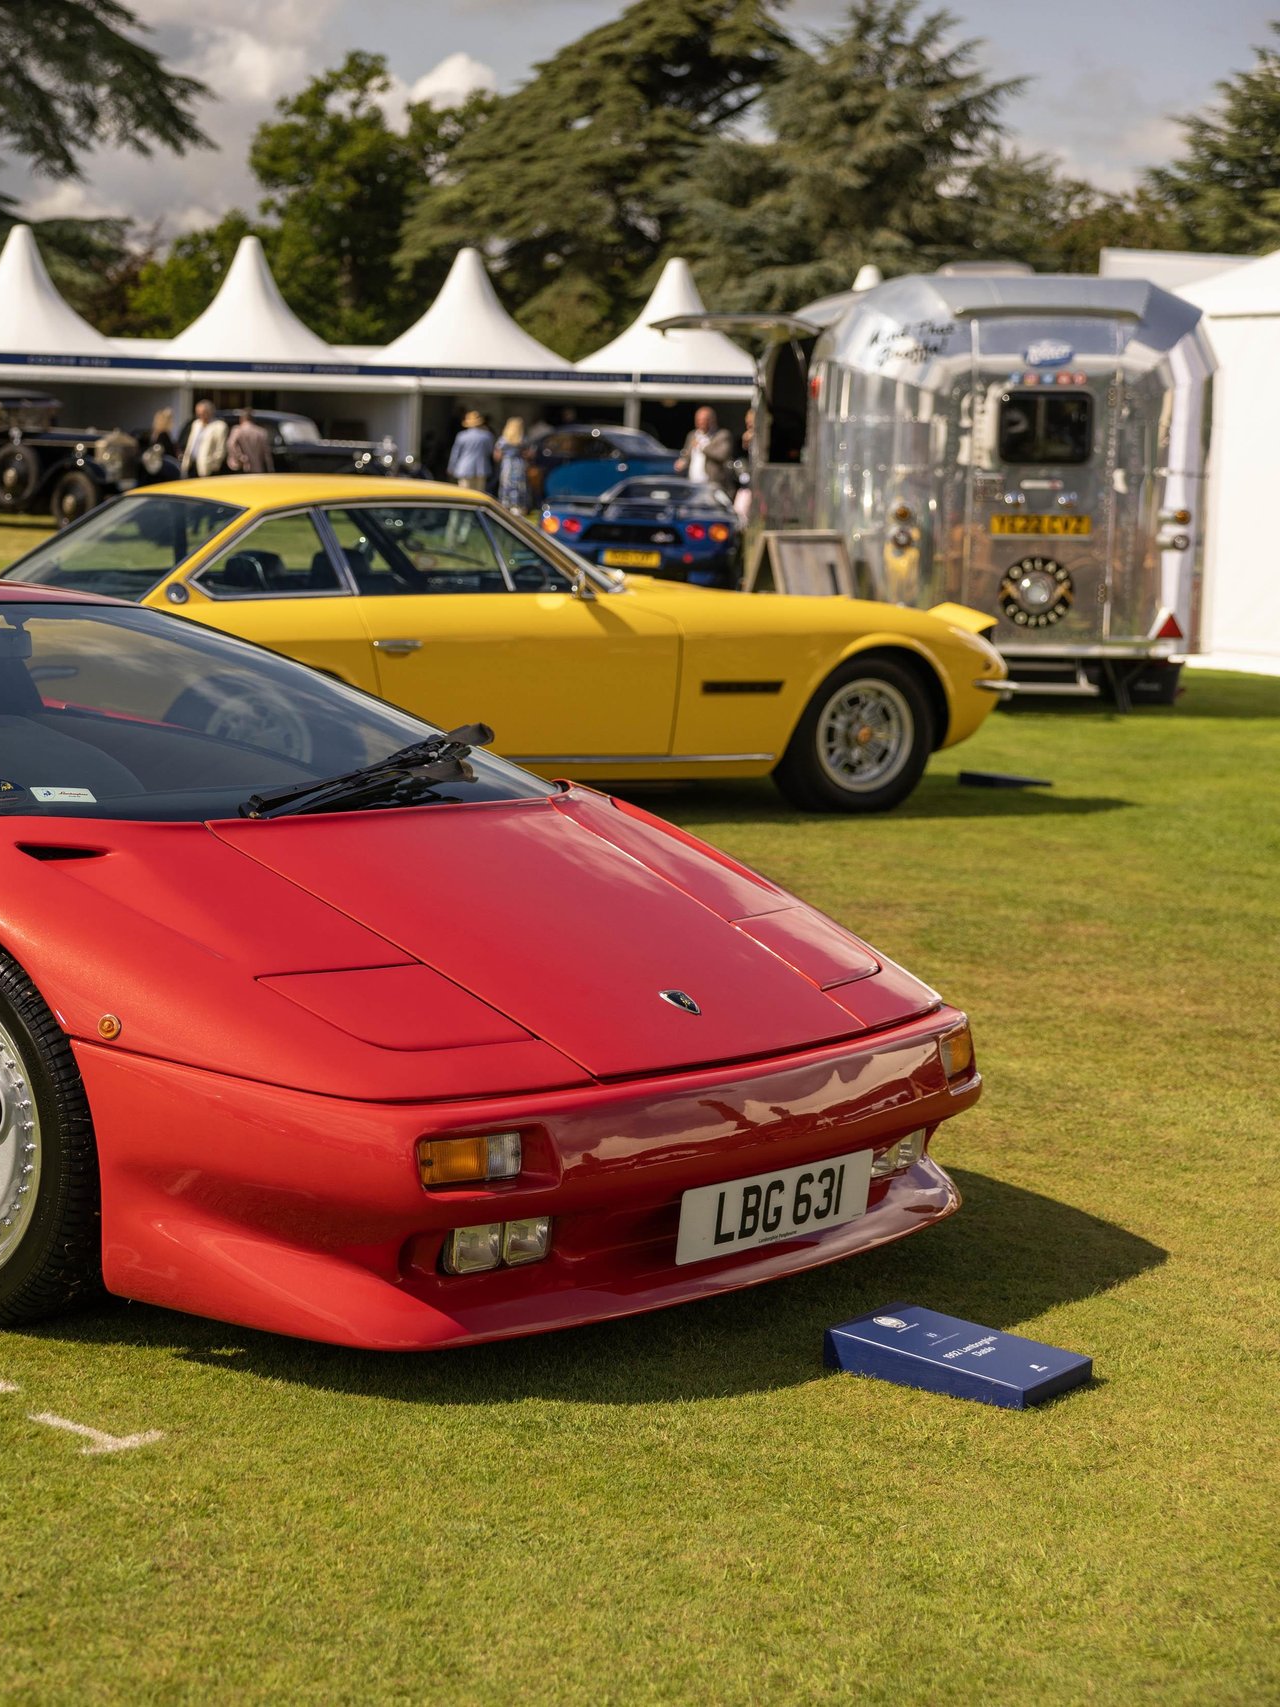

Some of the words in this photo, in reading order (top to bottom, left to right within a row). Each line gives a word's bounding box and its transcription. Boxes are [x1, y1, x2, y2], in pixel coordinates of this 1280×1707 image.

[714, 1180, 785, 1246] LBG
[792, 1164, 845, 1226] 631
[942, 1348, 963, 1359] 1992
[961, 1335, 998, 1353] Lamborghini
[970, 1346, 997, 1357] Diablo
